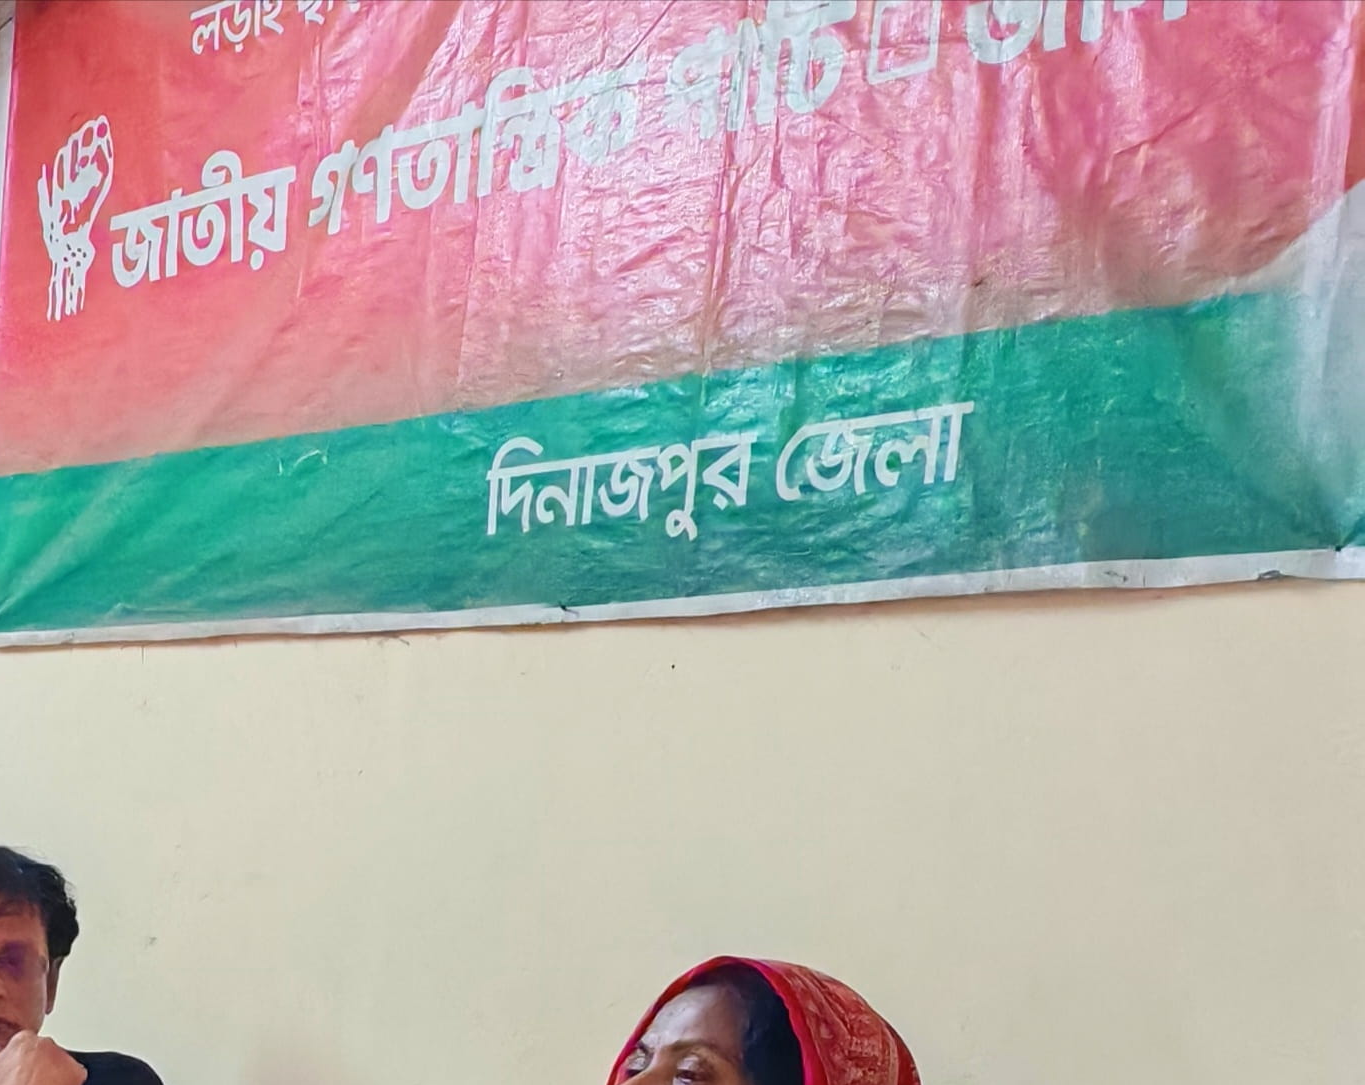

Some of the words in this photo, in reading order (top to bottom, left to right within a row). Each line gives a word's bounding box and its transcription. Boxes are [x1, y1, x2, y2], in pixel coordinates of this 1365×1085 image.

[109, 149, 296, 288] জাতীয়
[308, 62, 649, 236] গণতান্ত্রিক
[485, 431, 758, 542] দিনাজপুর
[775, 400, 975, 502] জেলা
